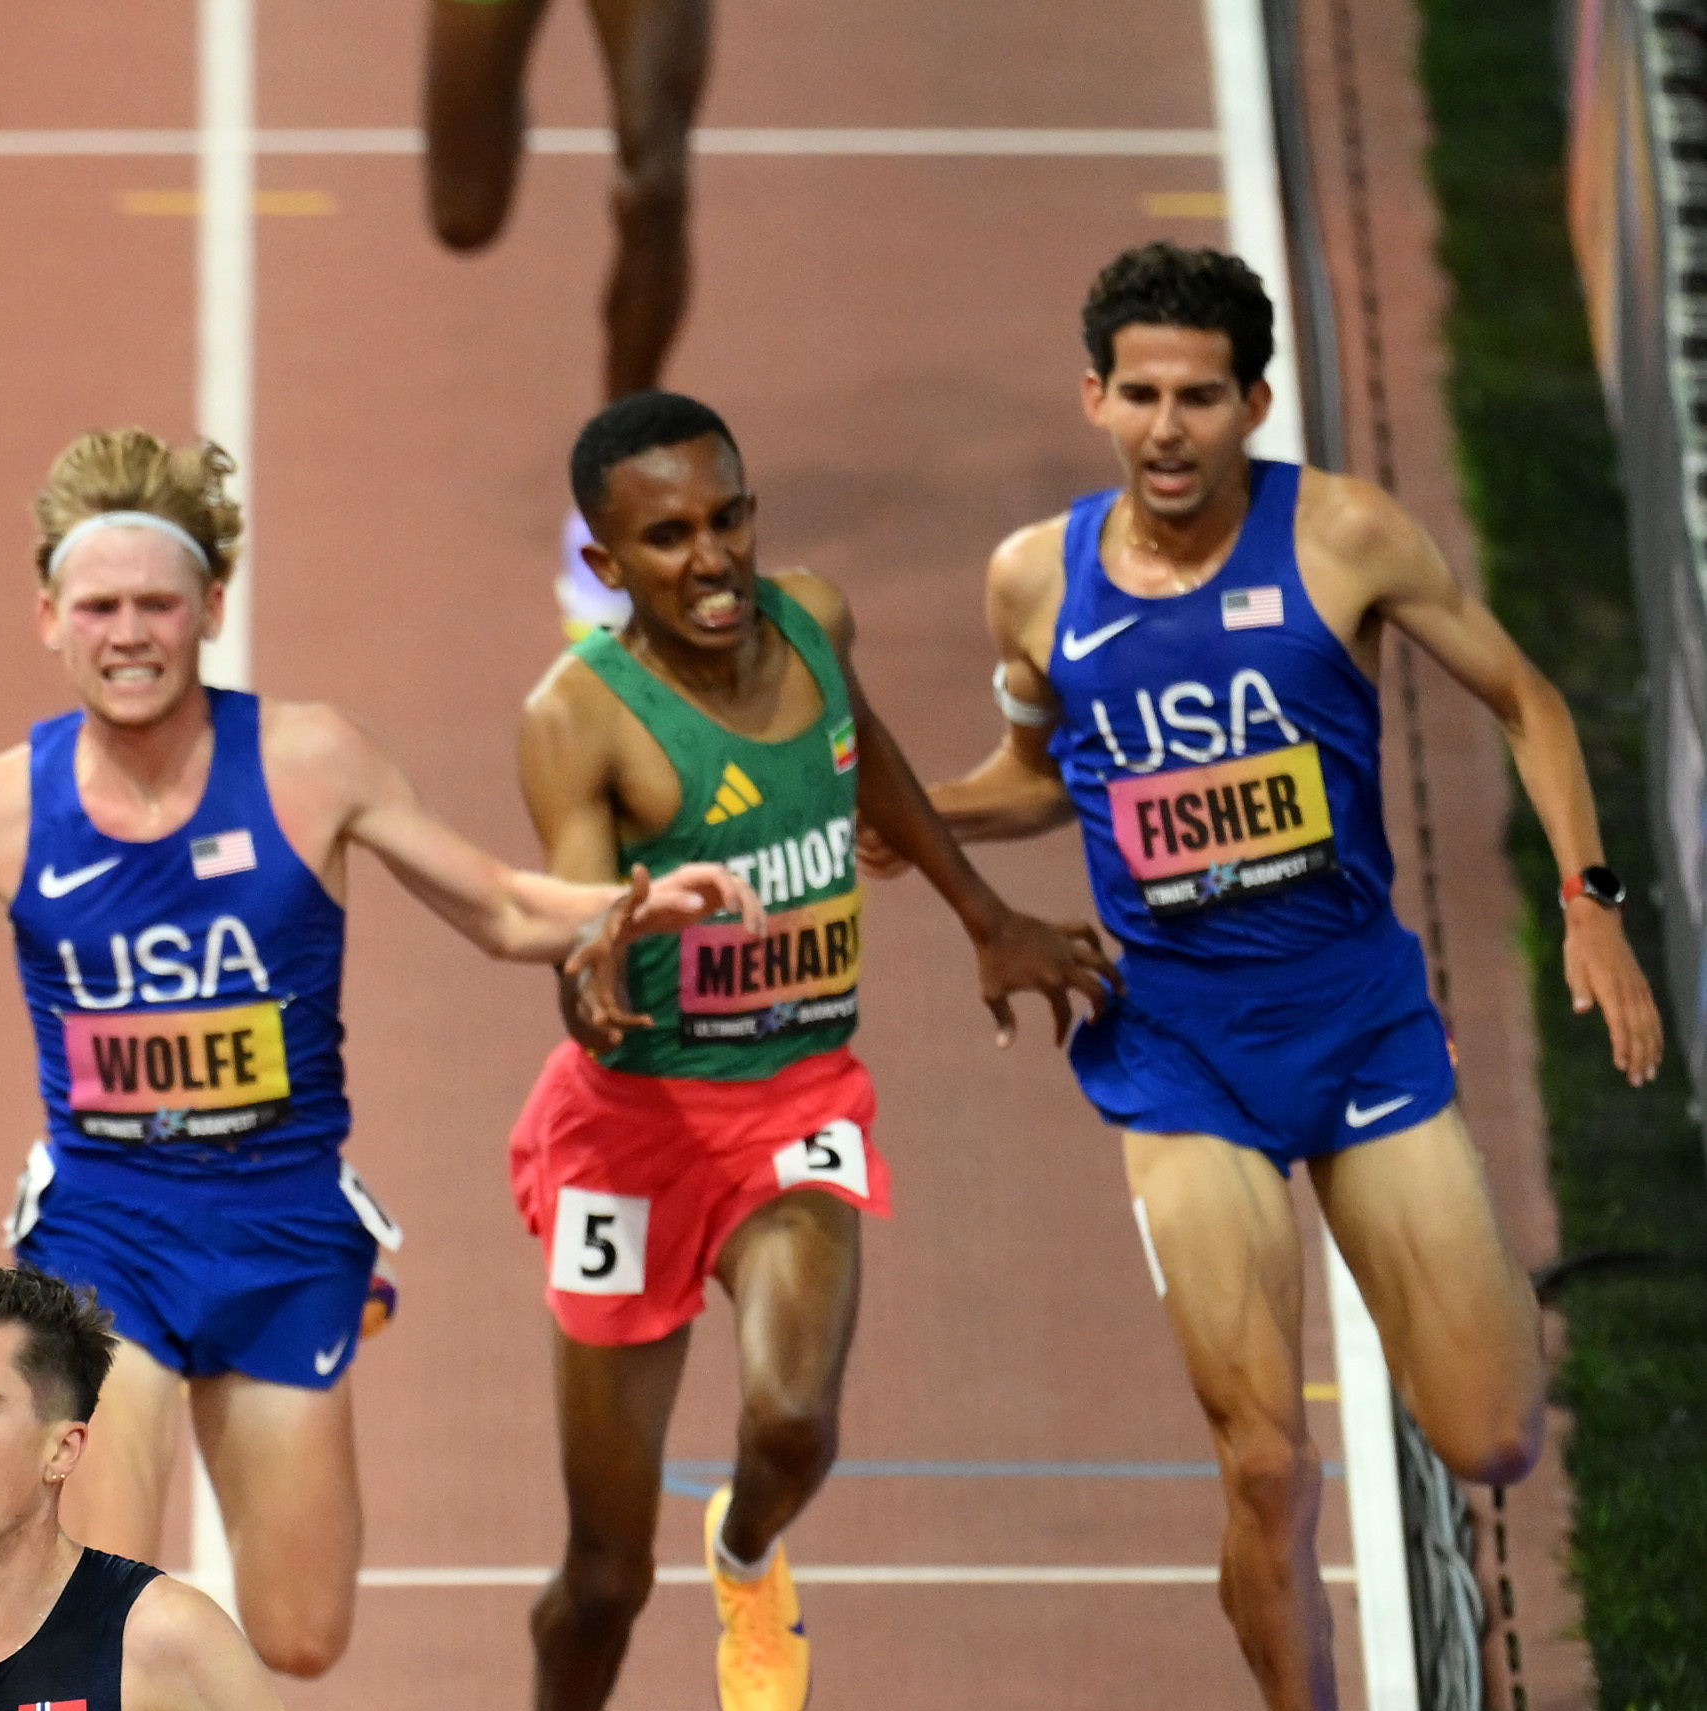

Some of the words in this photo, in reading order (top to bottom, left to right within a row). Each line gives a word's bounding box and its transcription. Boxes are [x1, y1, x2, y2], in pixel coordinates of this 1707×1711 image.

[1092, 669, 1300, 773] USA
[1136, 773, 1304, 860] FISHER
[725, 817, 858, 907] THIOP
[58, 915, 271, 1010] USA
[91, 1028, 258, 1094] WOLFE
[806, 1130, 842, 1170] 5
[580, 1214, 616, 1279] 5
